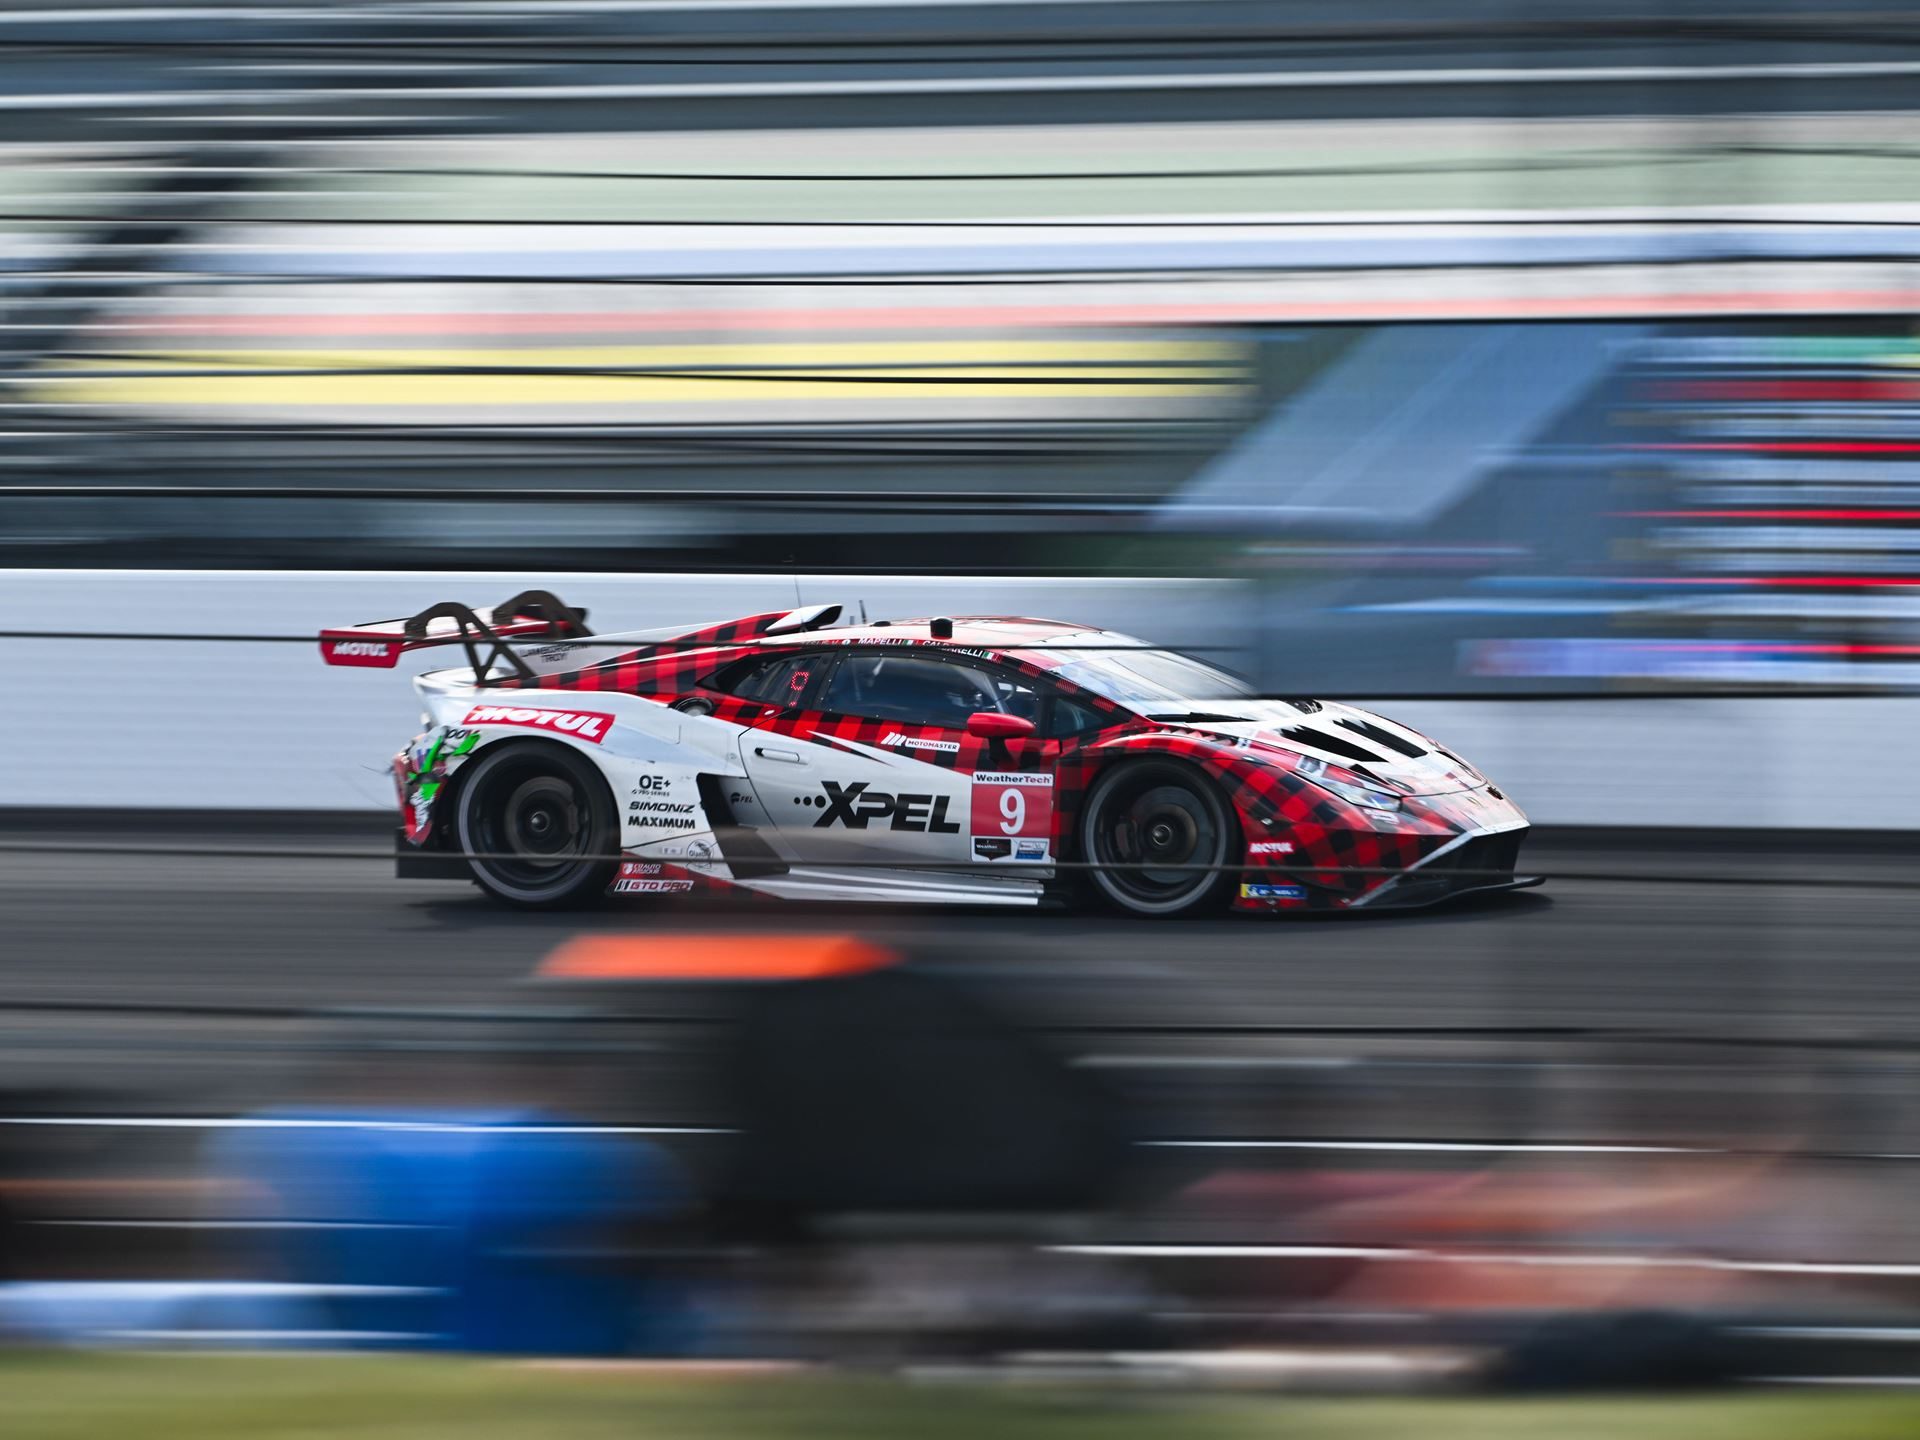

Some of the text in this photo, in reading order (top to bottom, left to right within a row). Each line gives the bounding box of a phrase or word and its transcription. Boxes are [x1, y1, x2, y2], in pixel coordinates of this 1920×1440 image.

[332, 641, 389, 657] MOTUL
[468, 706, 604, 738] MOTUL
[907, 739, 958, 750] MOTOMASTER
[976, 774, 1050, 784] WeatherTech
[629, 801, 695, 814] SIMONIZ
[813, 780, 961, 834] XPEL
[999, 788, 1026, 835] 9
[628, 815, 696, 829] MAXIMUM
[630, 881, 660, 890] GTD
